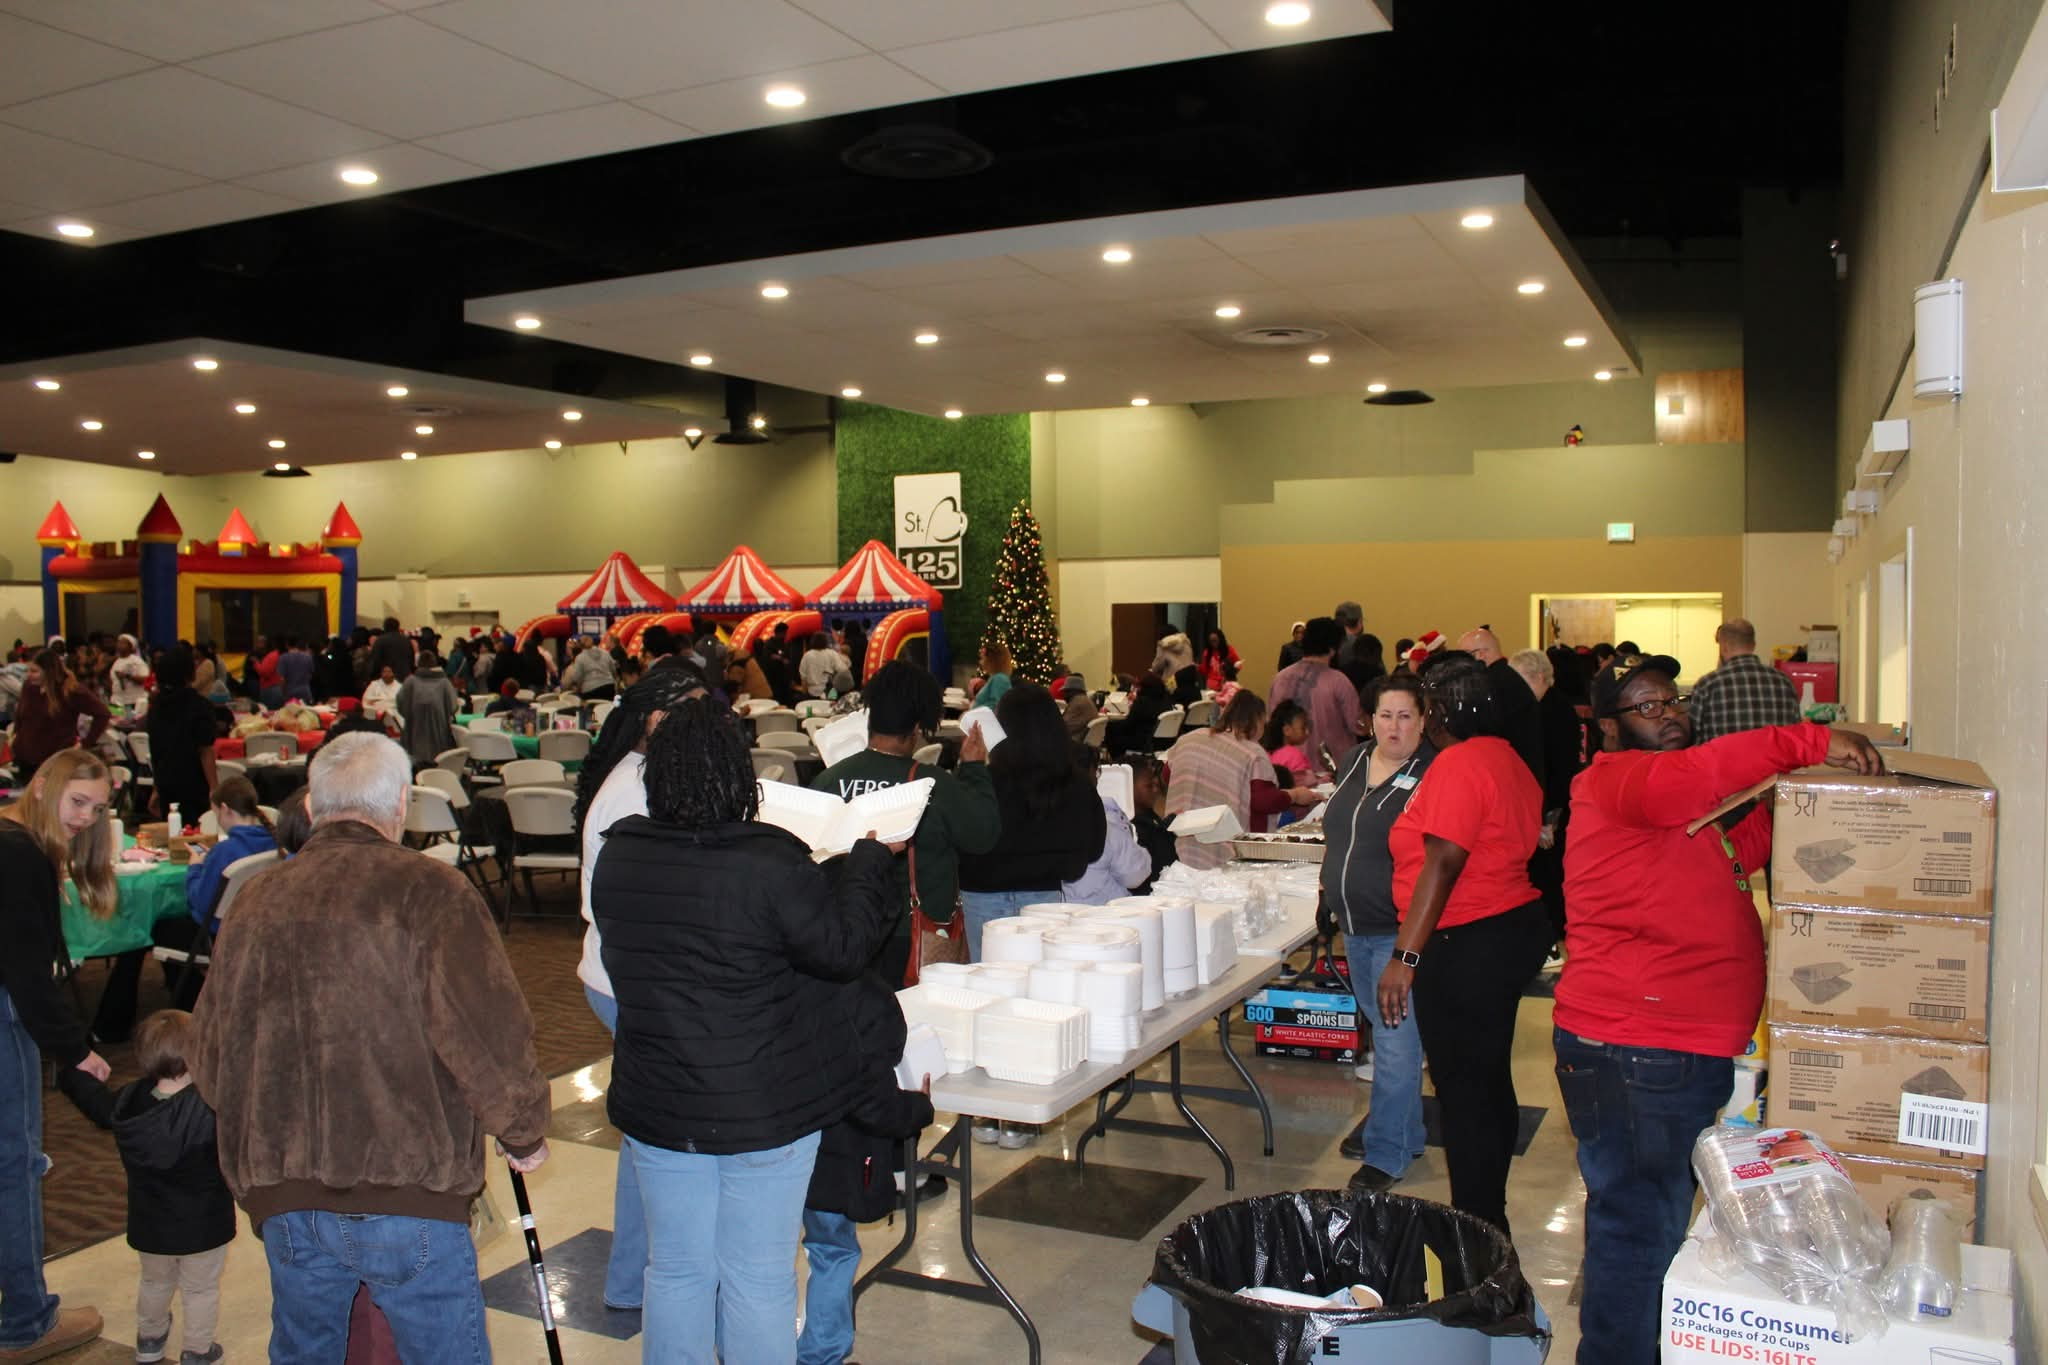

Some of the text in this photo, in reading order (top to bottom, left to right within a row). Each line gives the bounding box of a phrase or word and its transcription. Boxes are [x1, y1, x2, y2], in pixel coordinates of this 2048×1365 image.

[904, 511, 924, 533] St.
[901, 551, 957, 580] 125
[1246, 1005, 1275, 1022] 600
[1296, 1013, 1337, 1027] SPOONS
[1275, 1029, 1297, 1037] WHITE
[1298, 1031, 1326, 1039] PLASTIC
[1672, 1297, 1850, 1345] 20C16 Consumer
[1670, 1330, 1706, 1351] USE
[1711, 1338, 1760, 1361] LIDS:
[1671, 1316, 1811, 1352] 25 Packages of 20 Cups
